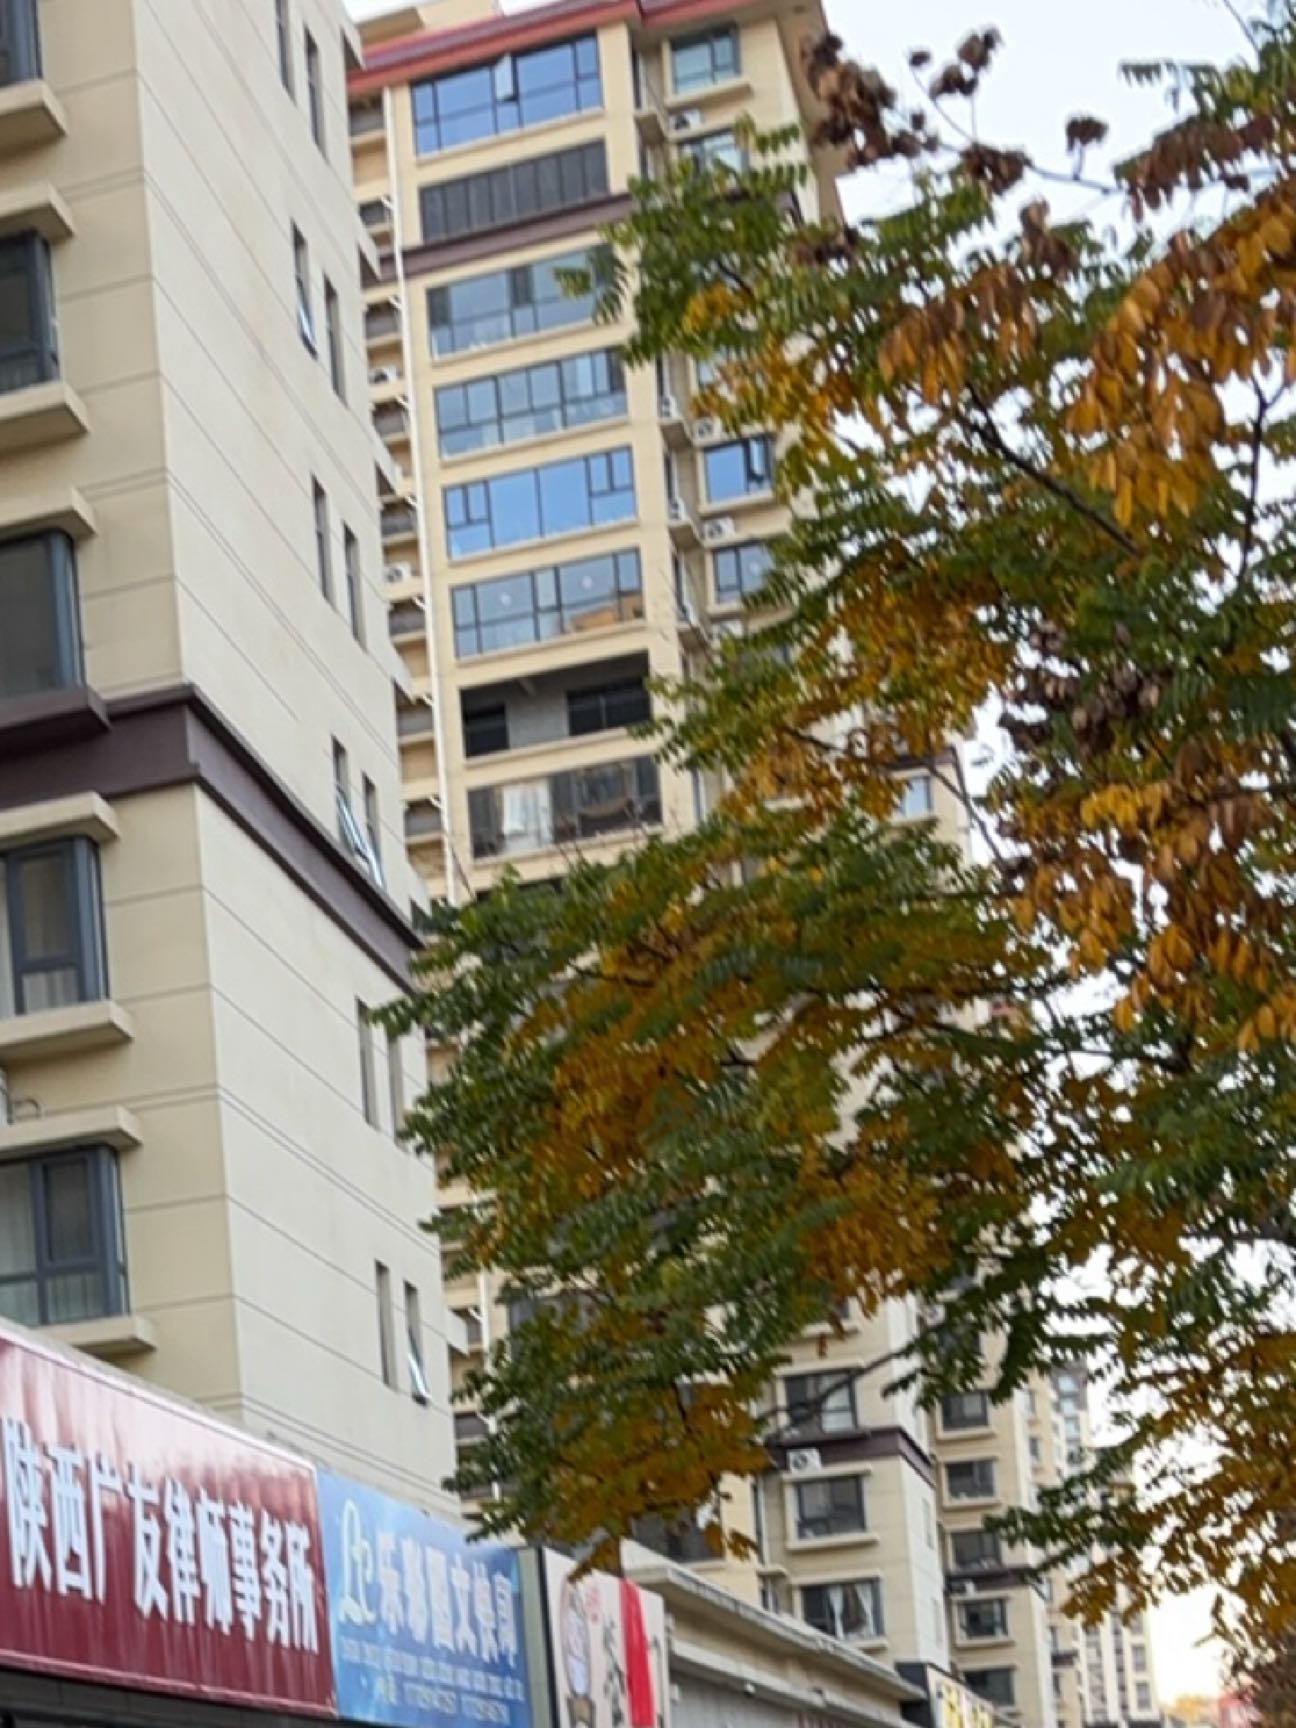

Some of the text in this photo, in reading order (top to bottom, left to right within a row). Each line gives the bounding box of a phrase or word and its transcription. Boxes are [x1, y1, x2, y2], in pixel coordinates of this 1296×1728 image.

[0, 1414, 319, 1655] 陕西广友律师事务所
